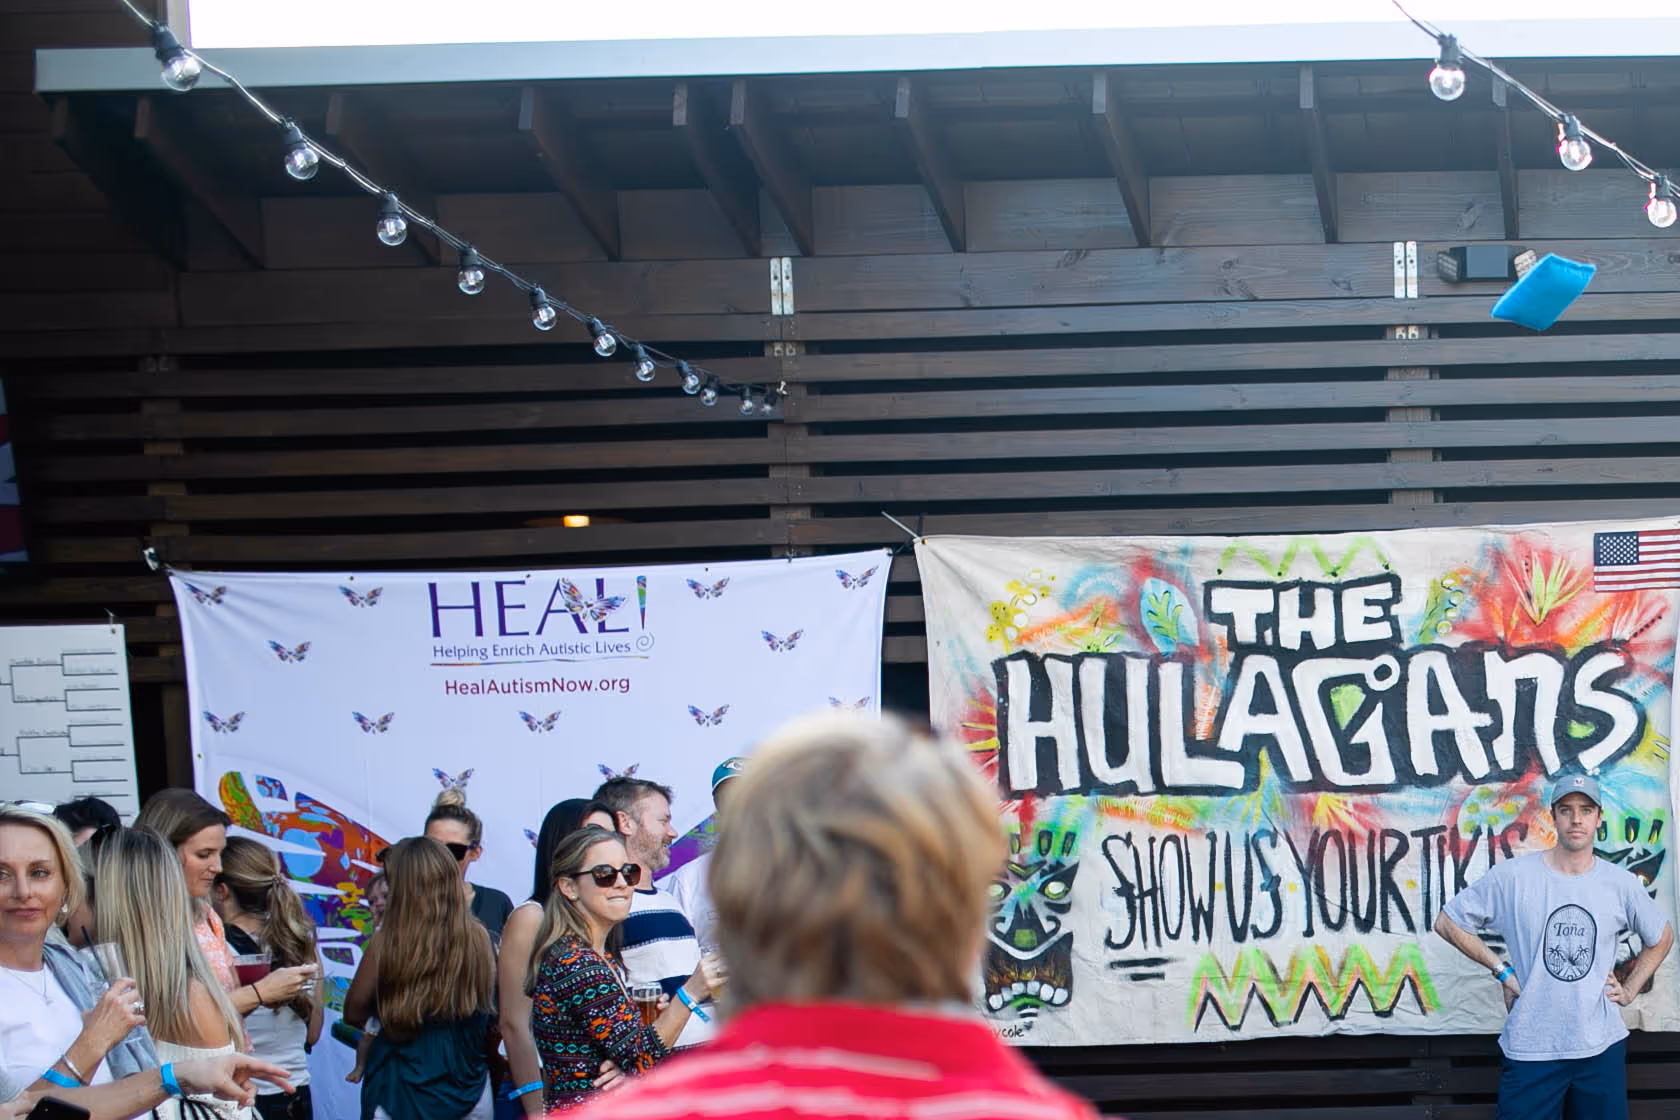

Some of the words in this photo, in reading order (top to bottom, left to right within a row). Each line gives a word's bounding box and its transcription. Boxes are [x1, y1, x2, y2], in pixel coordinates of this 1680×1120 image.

[1205, 576, 1402, 650] THE
[433, 644, 488, 660] Helping
[493, 643, 535, 657] Enrich
[540, 641, 592, 656] Autistic
[596, 641, 631, 654] Lives
[445, 677, 630, 695] HealAutismNow.org
[1102, 832, 1216, 949] SHOW
[1224, 829, 1283, 943] US
[1284, 826, 1416, 937] YOUR
[1410, 823, 1528, 932] TIK
[1554, 923, 1585, 936] Toña
